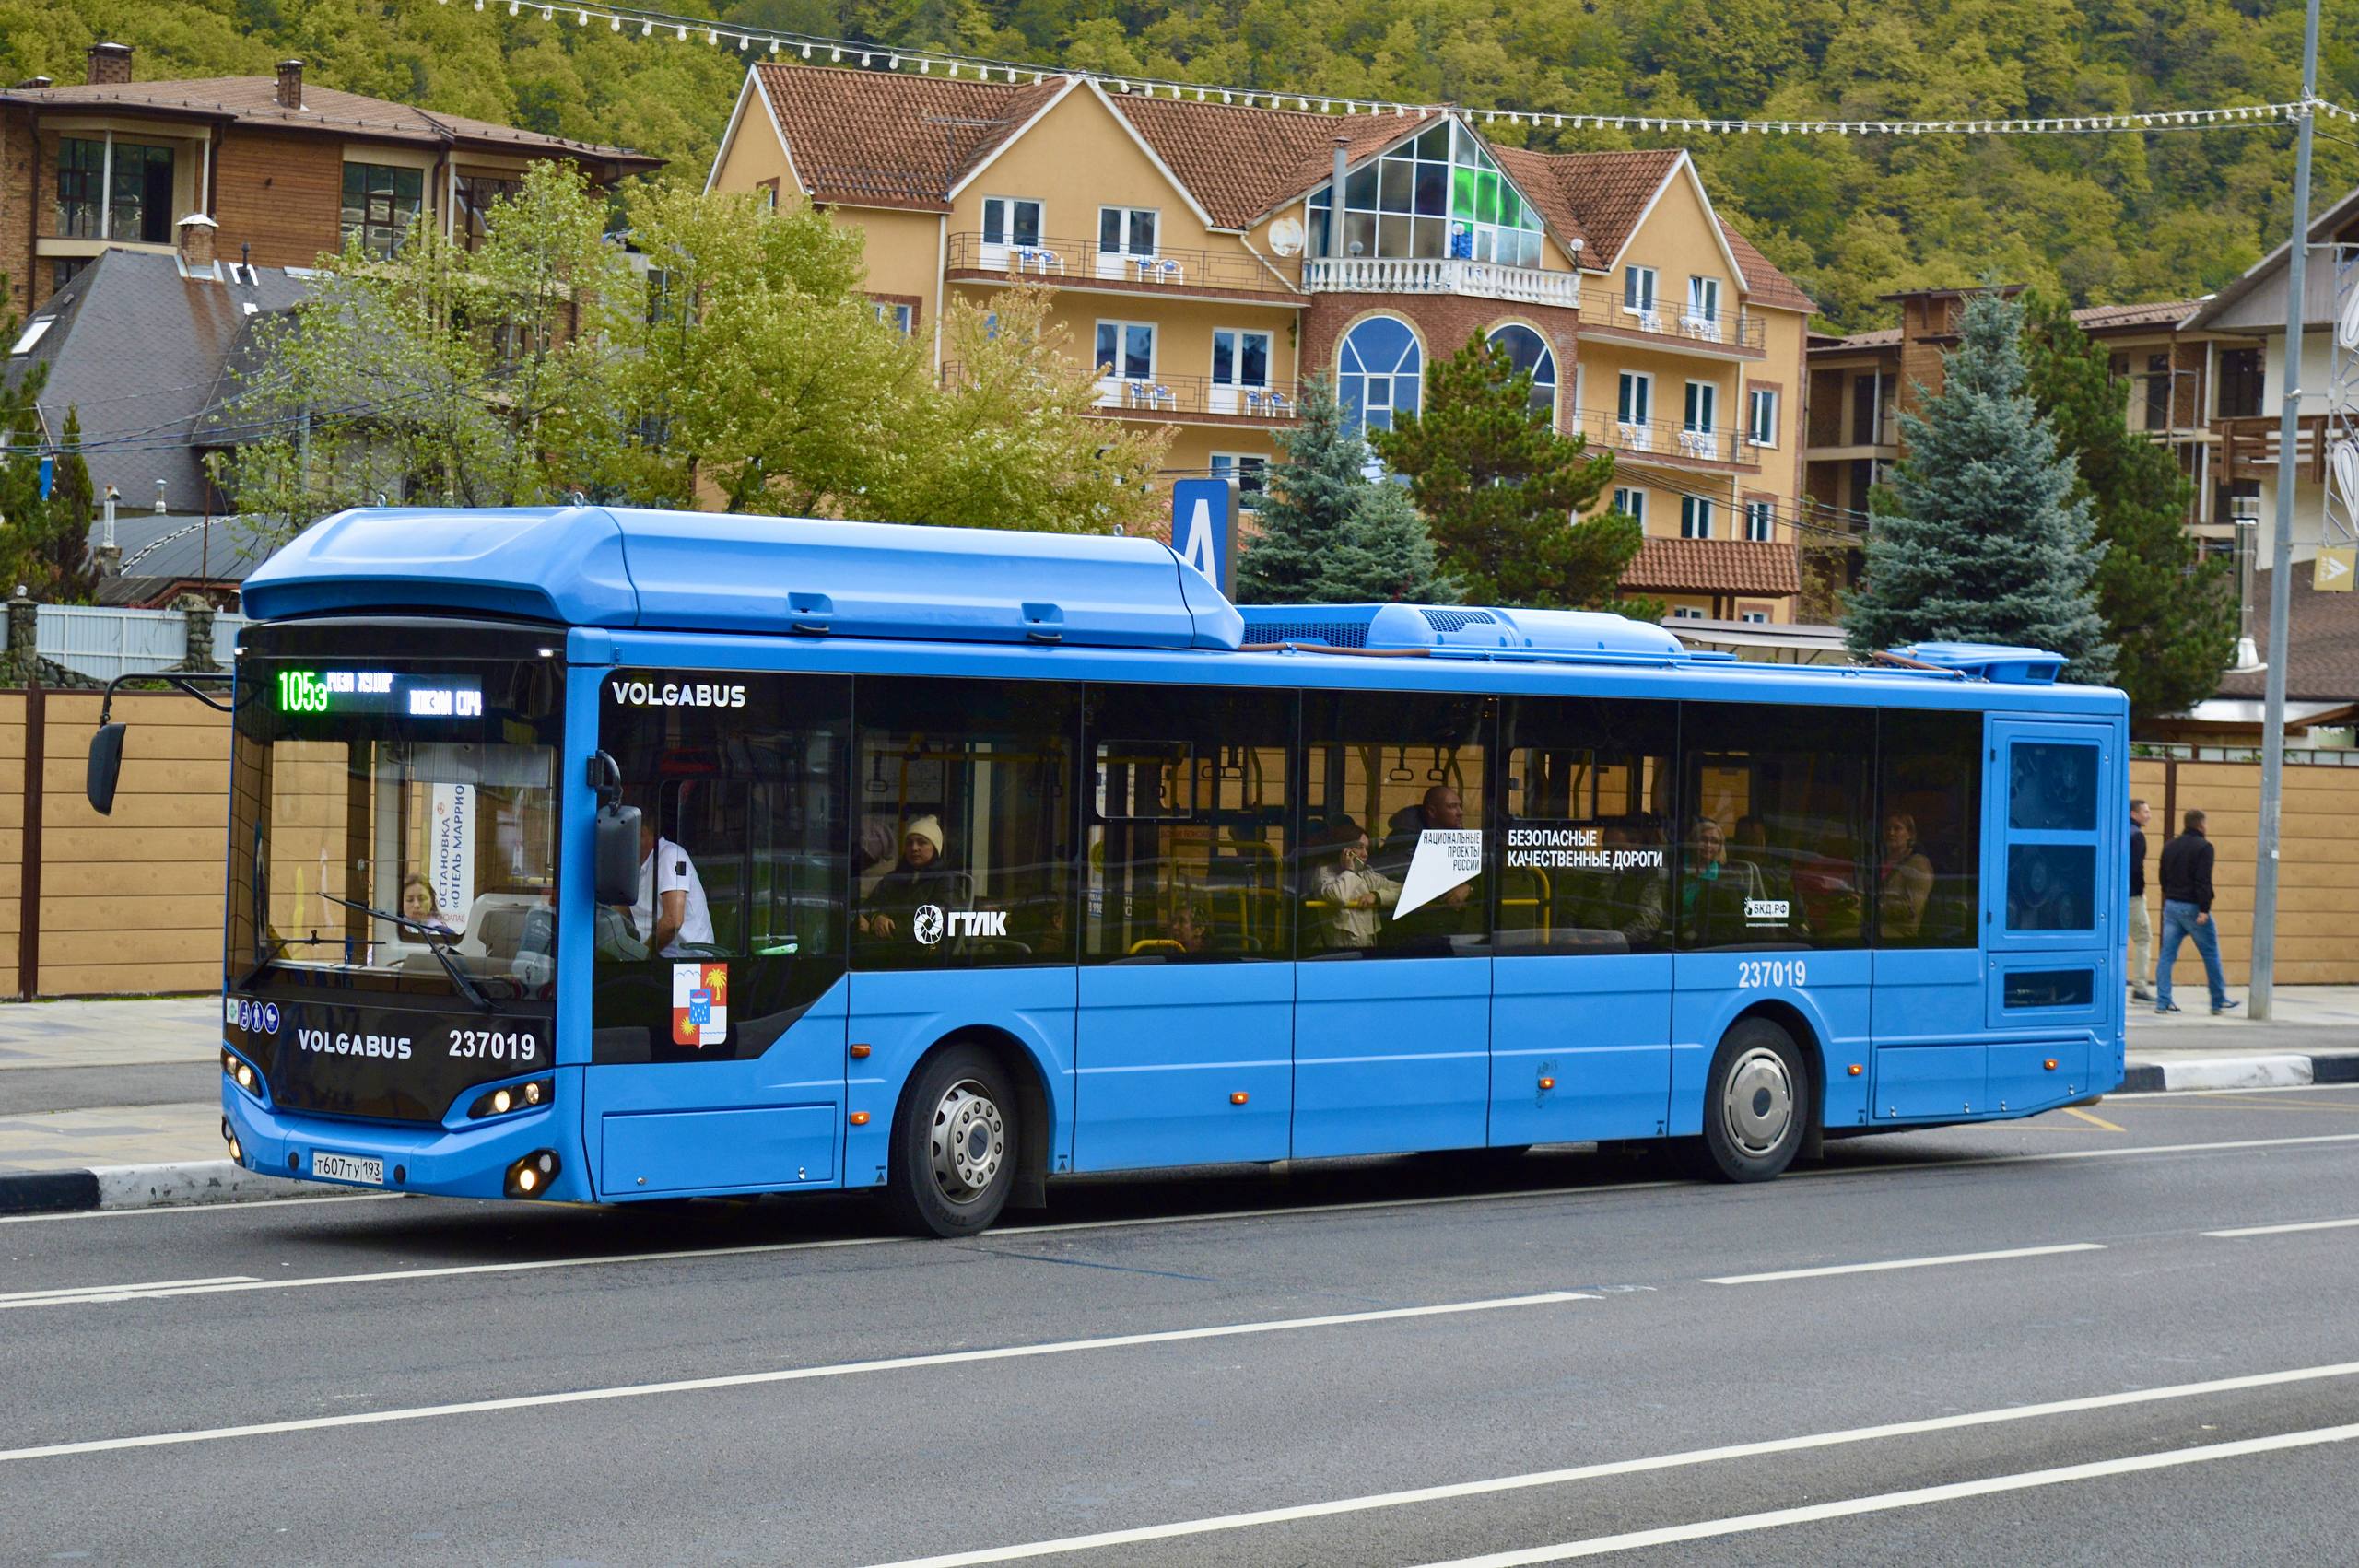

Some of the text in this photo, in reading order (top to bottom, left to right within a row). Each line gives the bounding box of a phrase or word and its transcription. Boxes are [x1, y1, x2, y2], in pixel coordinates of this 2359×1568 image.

[612, 681, 745, 708] VOLGABUS
[1423, 832, 1480, 845] НАЦИОНАЛЬНЫЕ
[1508, 829, 1597, 847] БЕЗОПАСНЫЕ
[439, 817, 451, 907] ОСТАНОВКА
[1447, 845, 1480, 858] ПРОЕКТЫ
[1508, 850, 1663, 870] КАЧЕСТВЕННЫЕ ДОРОГИ
[1452, 859, 1480, 871] РОССИИ
[947, 911, 1007, 937] ГТЛК
[1738, 960, 1806, 989] 237019
[298, 1028, 412, 1059] VOLGABUS
[449, 1029, 536, 1060] 237019
